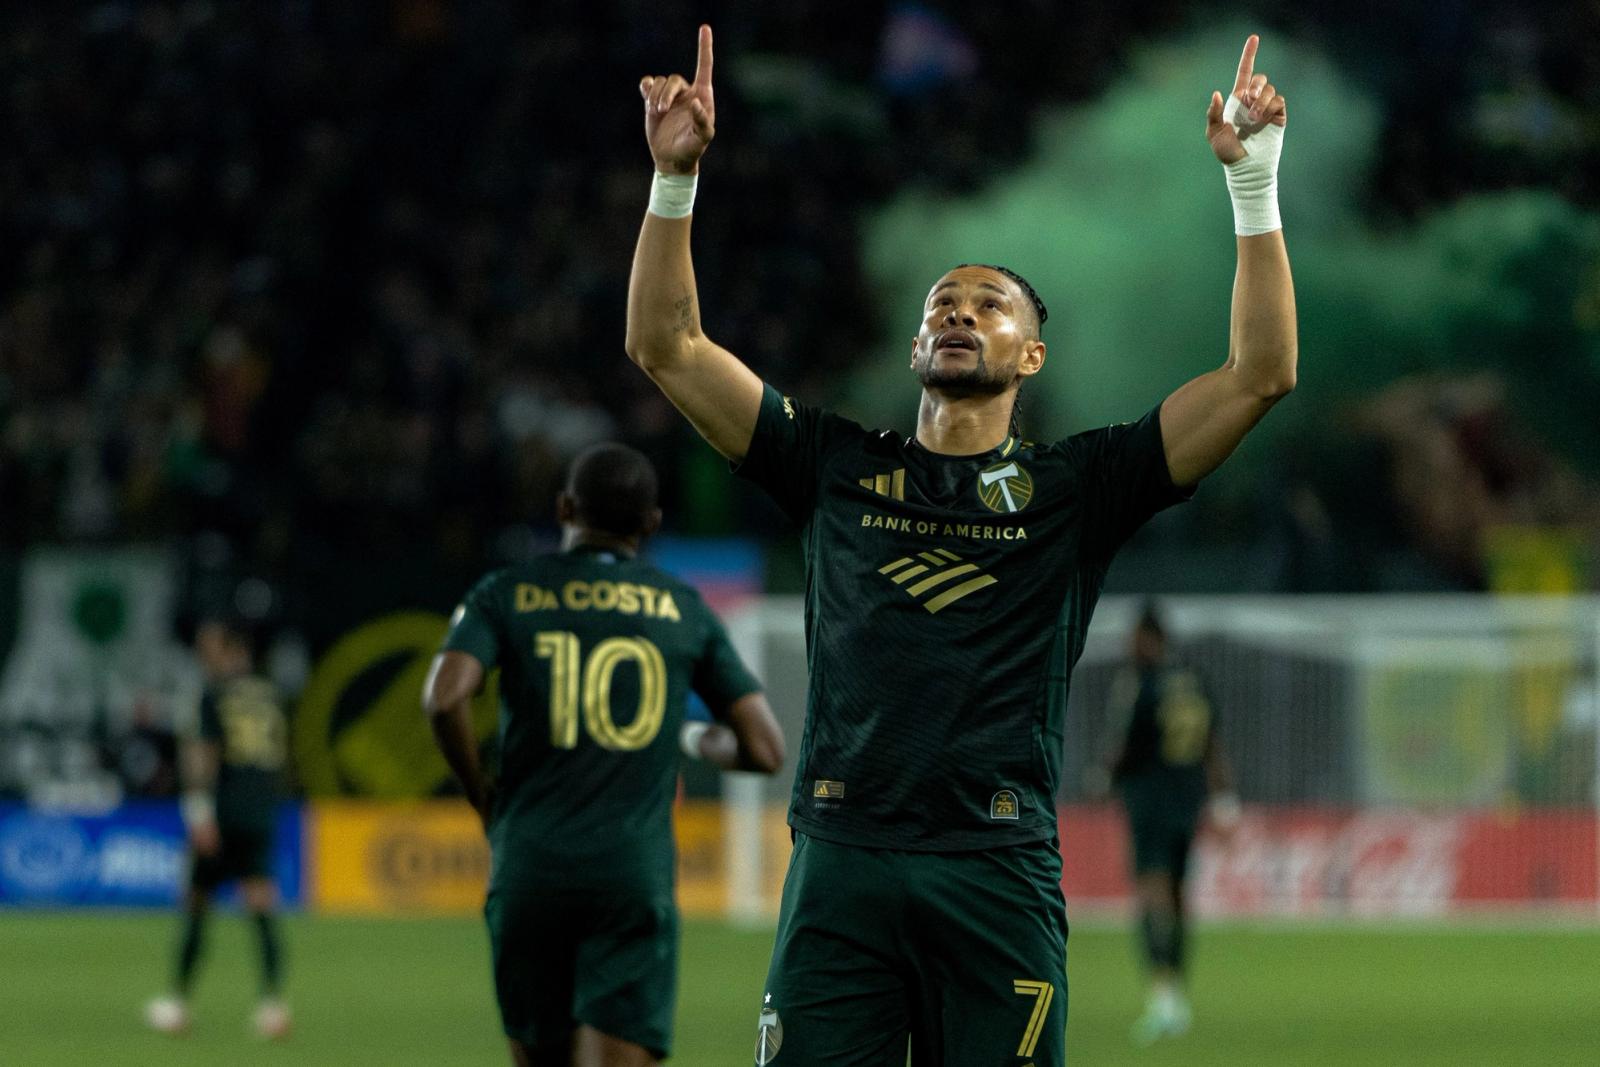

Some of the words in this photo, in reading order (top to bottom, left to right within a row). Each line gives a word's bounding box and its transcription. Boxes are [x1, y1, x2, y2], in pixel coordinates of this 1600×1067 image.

[861, 514, 911, 532] BANK
[916, 521, 938, 535] OF
[943, 524, 1028, 540] AMERICA
[563, 580, 682, 622] COSTA
[534, 631, 668, 751] 10
[1013, 979, 1055, 1057] 7
